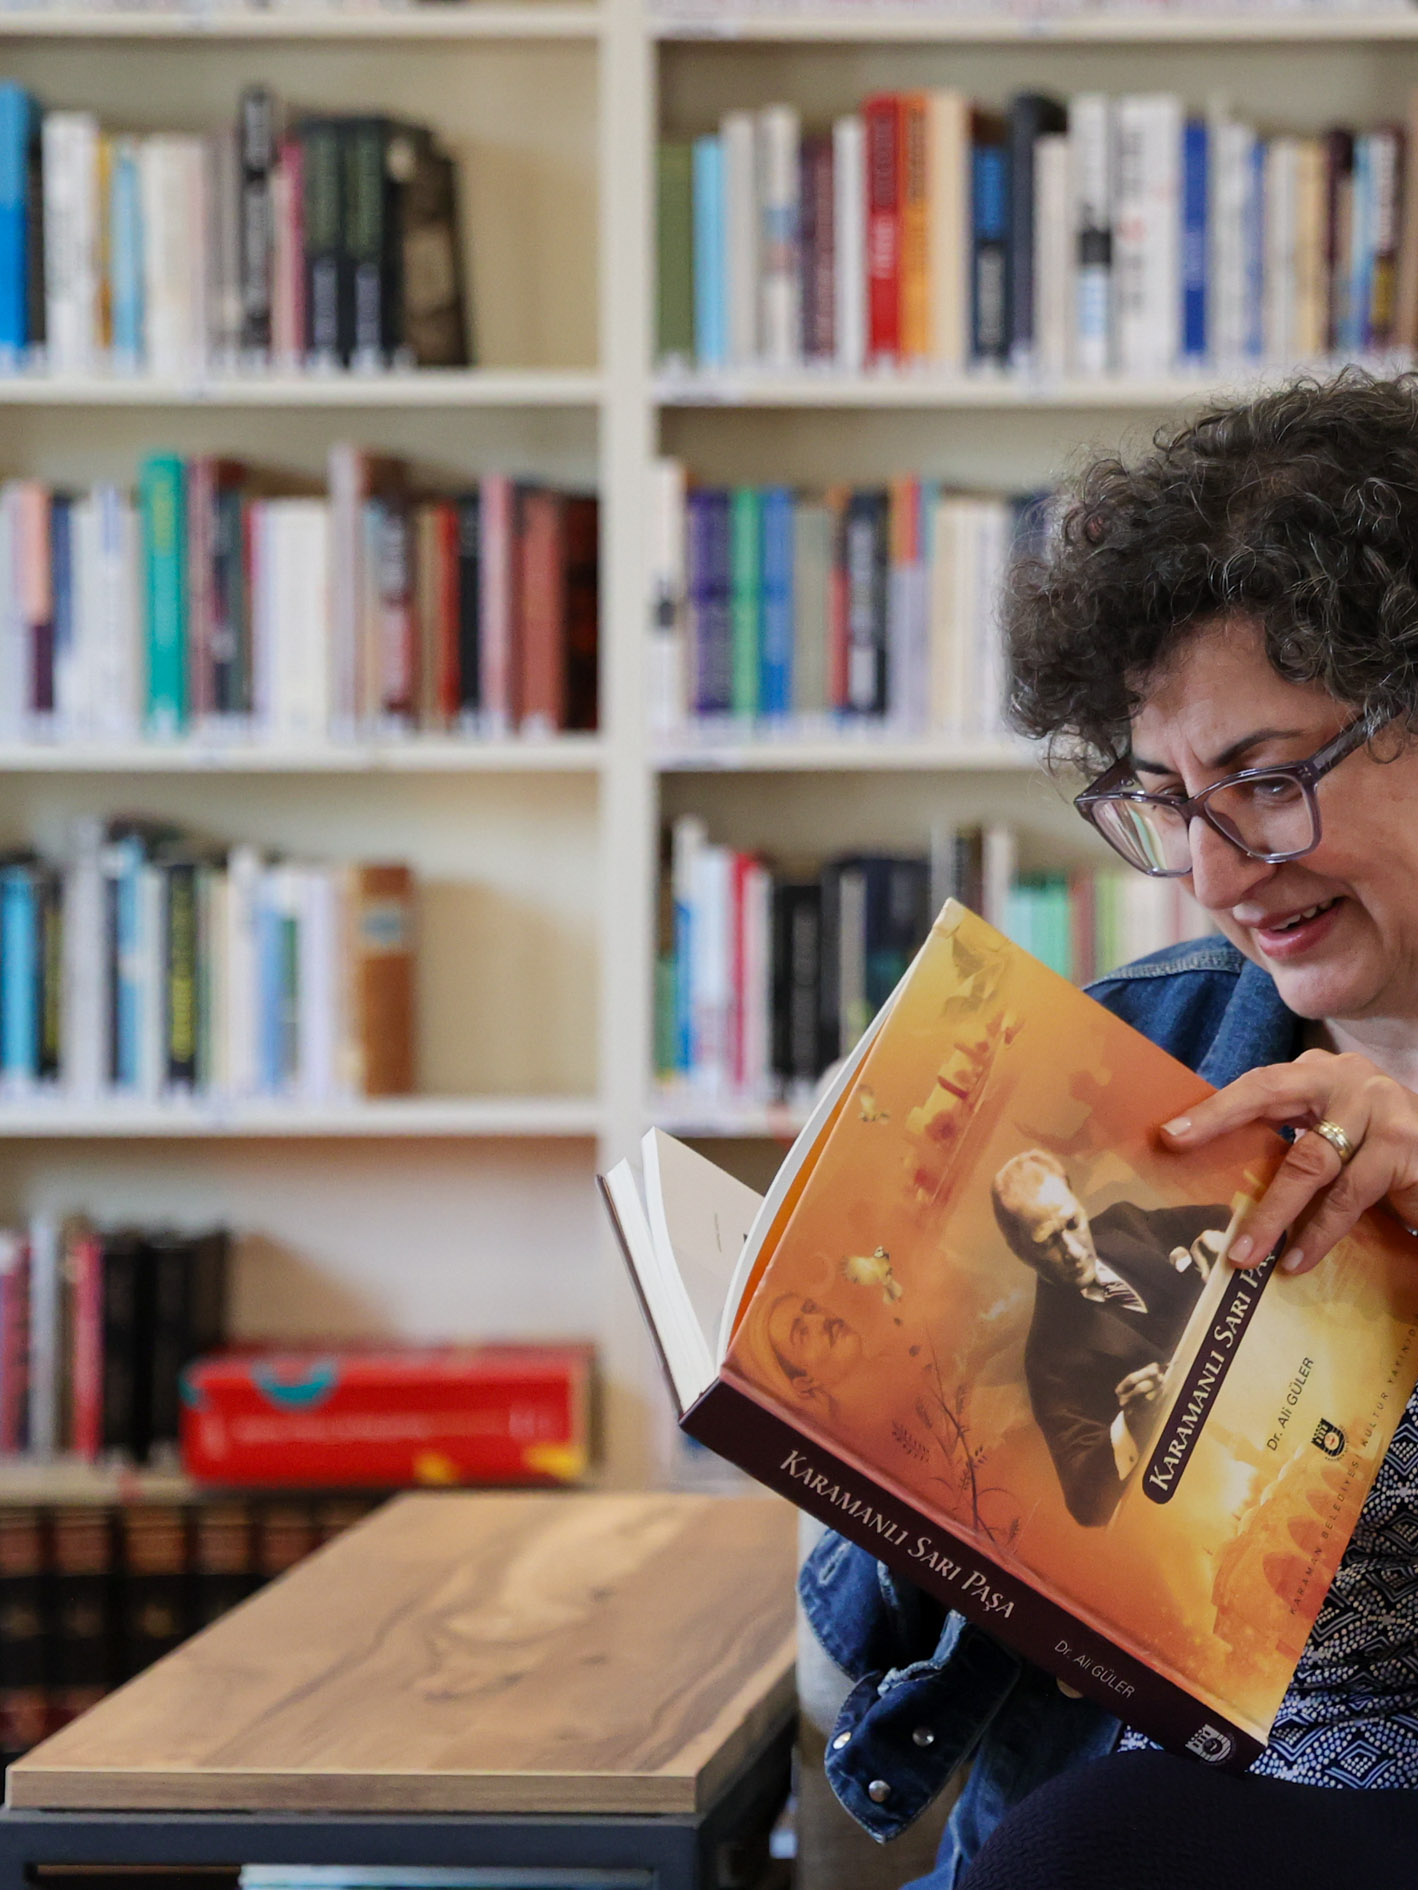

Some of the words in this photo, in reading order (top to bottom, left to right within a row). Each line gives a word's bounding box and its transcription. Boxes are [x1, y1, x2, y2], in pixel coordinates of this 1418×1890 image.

[1149, 1350, 1225, 1491] KARAMANLI
[1213, 1290, 1251, 1348] SARI
[1266, 1432, 1283, 1451] Dr.
[1277, 1406, 1292, 1429] Ali
[1286, 1357, 1314, 1406] GÜLER
[780, 1450, 909, 1546] KARAMANLI
[907, 1536, 962, 1581] SARI
[961, 1570, 1015, 1619] PAŞA
[1290, 1546, 1323, 1616] KARAMAN
[1054, 1639, 1073, 1658] Dr.
[1073, 1654, 1092, 1670] Ali
[1091, 1665, 1136, 1699] GÜLER
